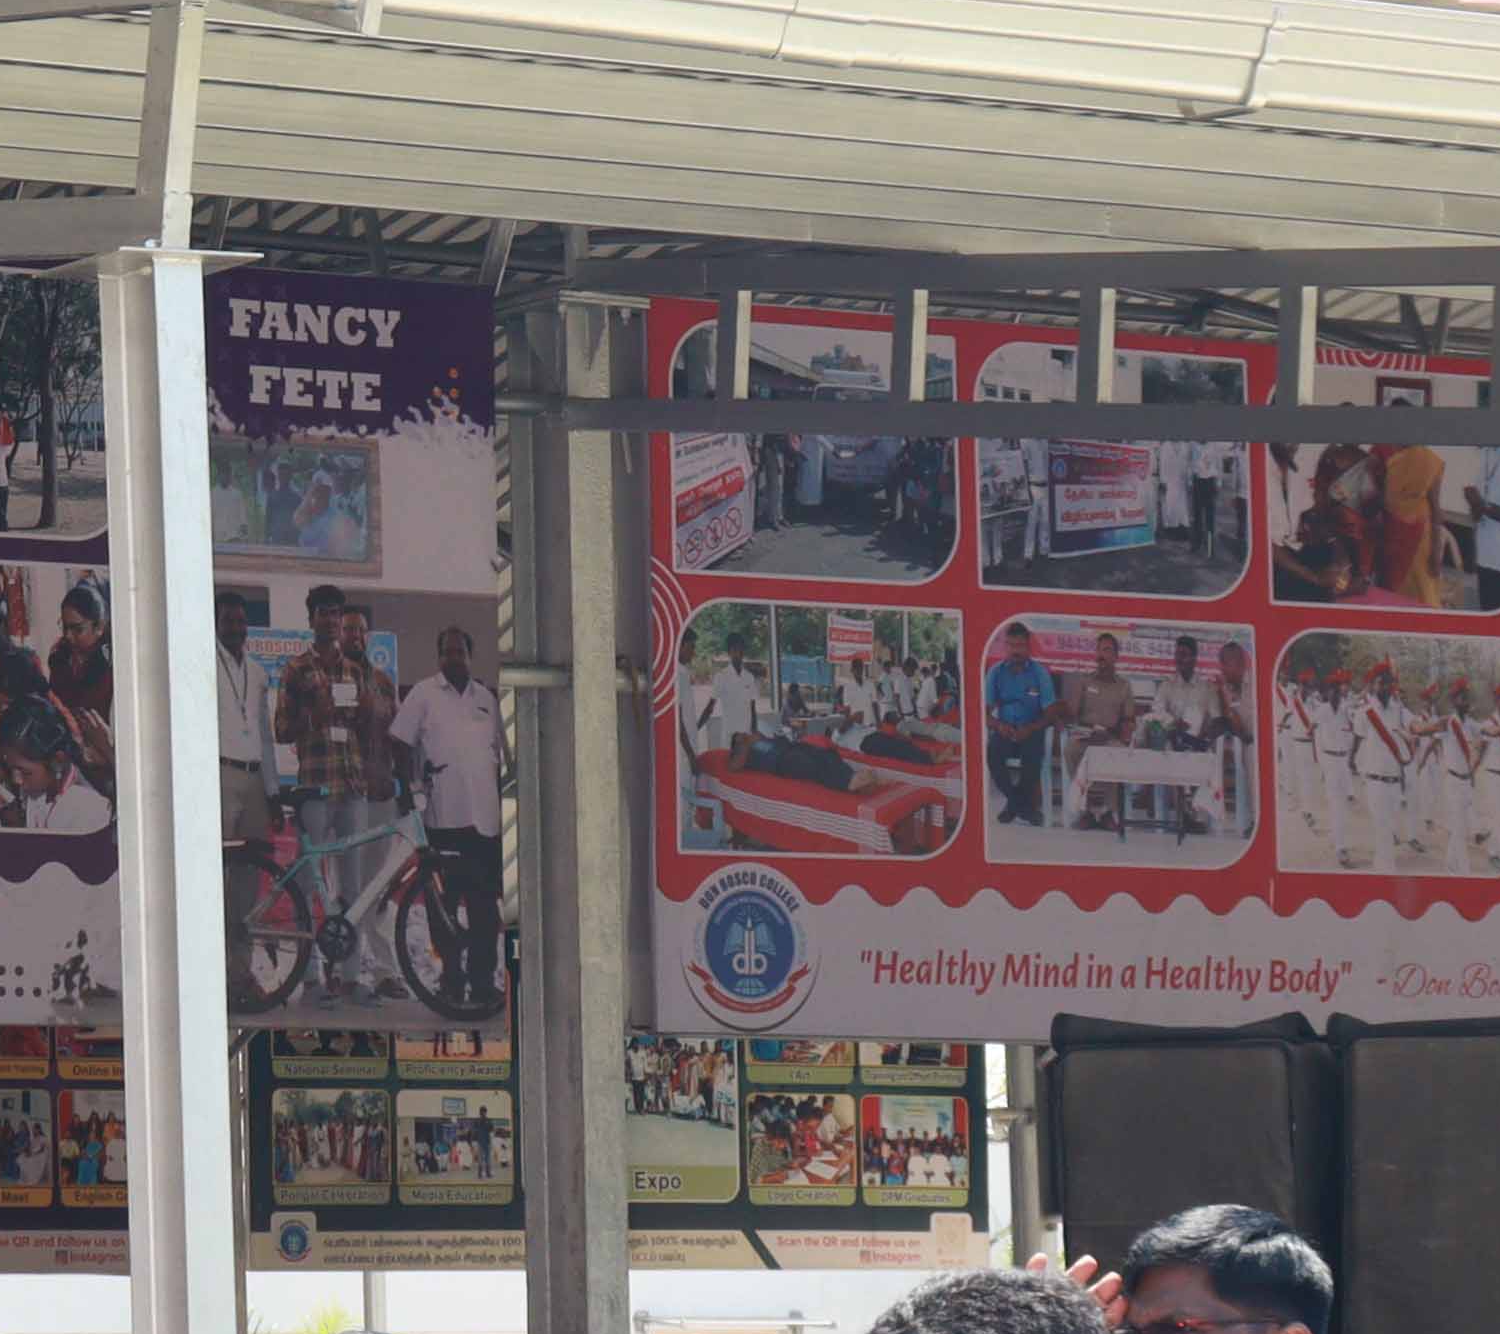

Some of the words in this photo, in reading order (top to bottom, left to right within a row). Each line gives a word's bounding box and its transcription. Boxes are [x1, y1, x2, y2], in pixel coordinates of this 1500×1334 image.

[228, 298, 401, 348] FANCY
[248, 364, 382, 412] FETE
[859, 948, 994, 996] "Healthy
[1001, 950, 1081, 990] Mind
[1085, 952, 1113, 990] in
[1119, 963, 1136, 990] a
[1144, 954, 1262, 1001] Healthy
[1266, 957, 1354, 1003] Body"
[1391, 962, 1451, 998] Don
[633, 1171, 682, 1193] Expo
[412, 1188, 445, 1202] Media
[446, 1188, 503, 1202] Education
[12, 1235, 31, 1248] QR
[32, 1235, 55, 1248] and
[57, 1235, 91, 1248] follow
[93, 1236, 107, 1249] us
[776, 1235, 803, 1248] Scan
[804, 1235, 820, 1248] the
[822, 1235, 839, 1248] QR
[841, 1235, 860, 1248] and
[861, 1235, 891, 1248] follow
[893, 1236, 905, 1248] us
[908, 1236, 921, 1248] on
[871, 1250, 922, 1264] Instagram
